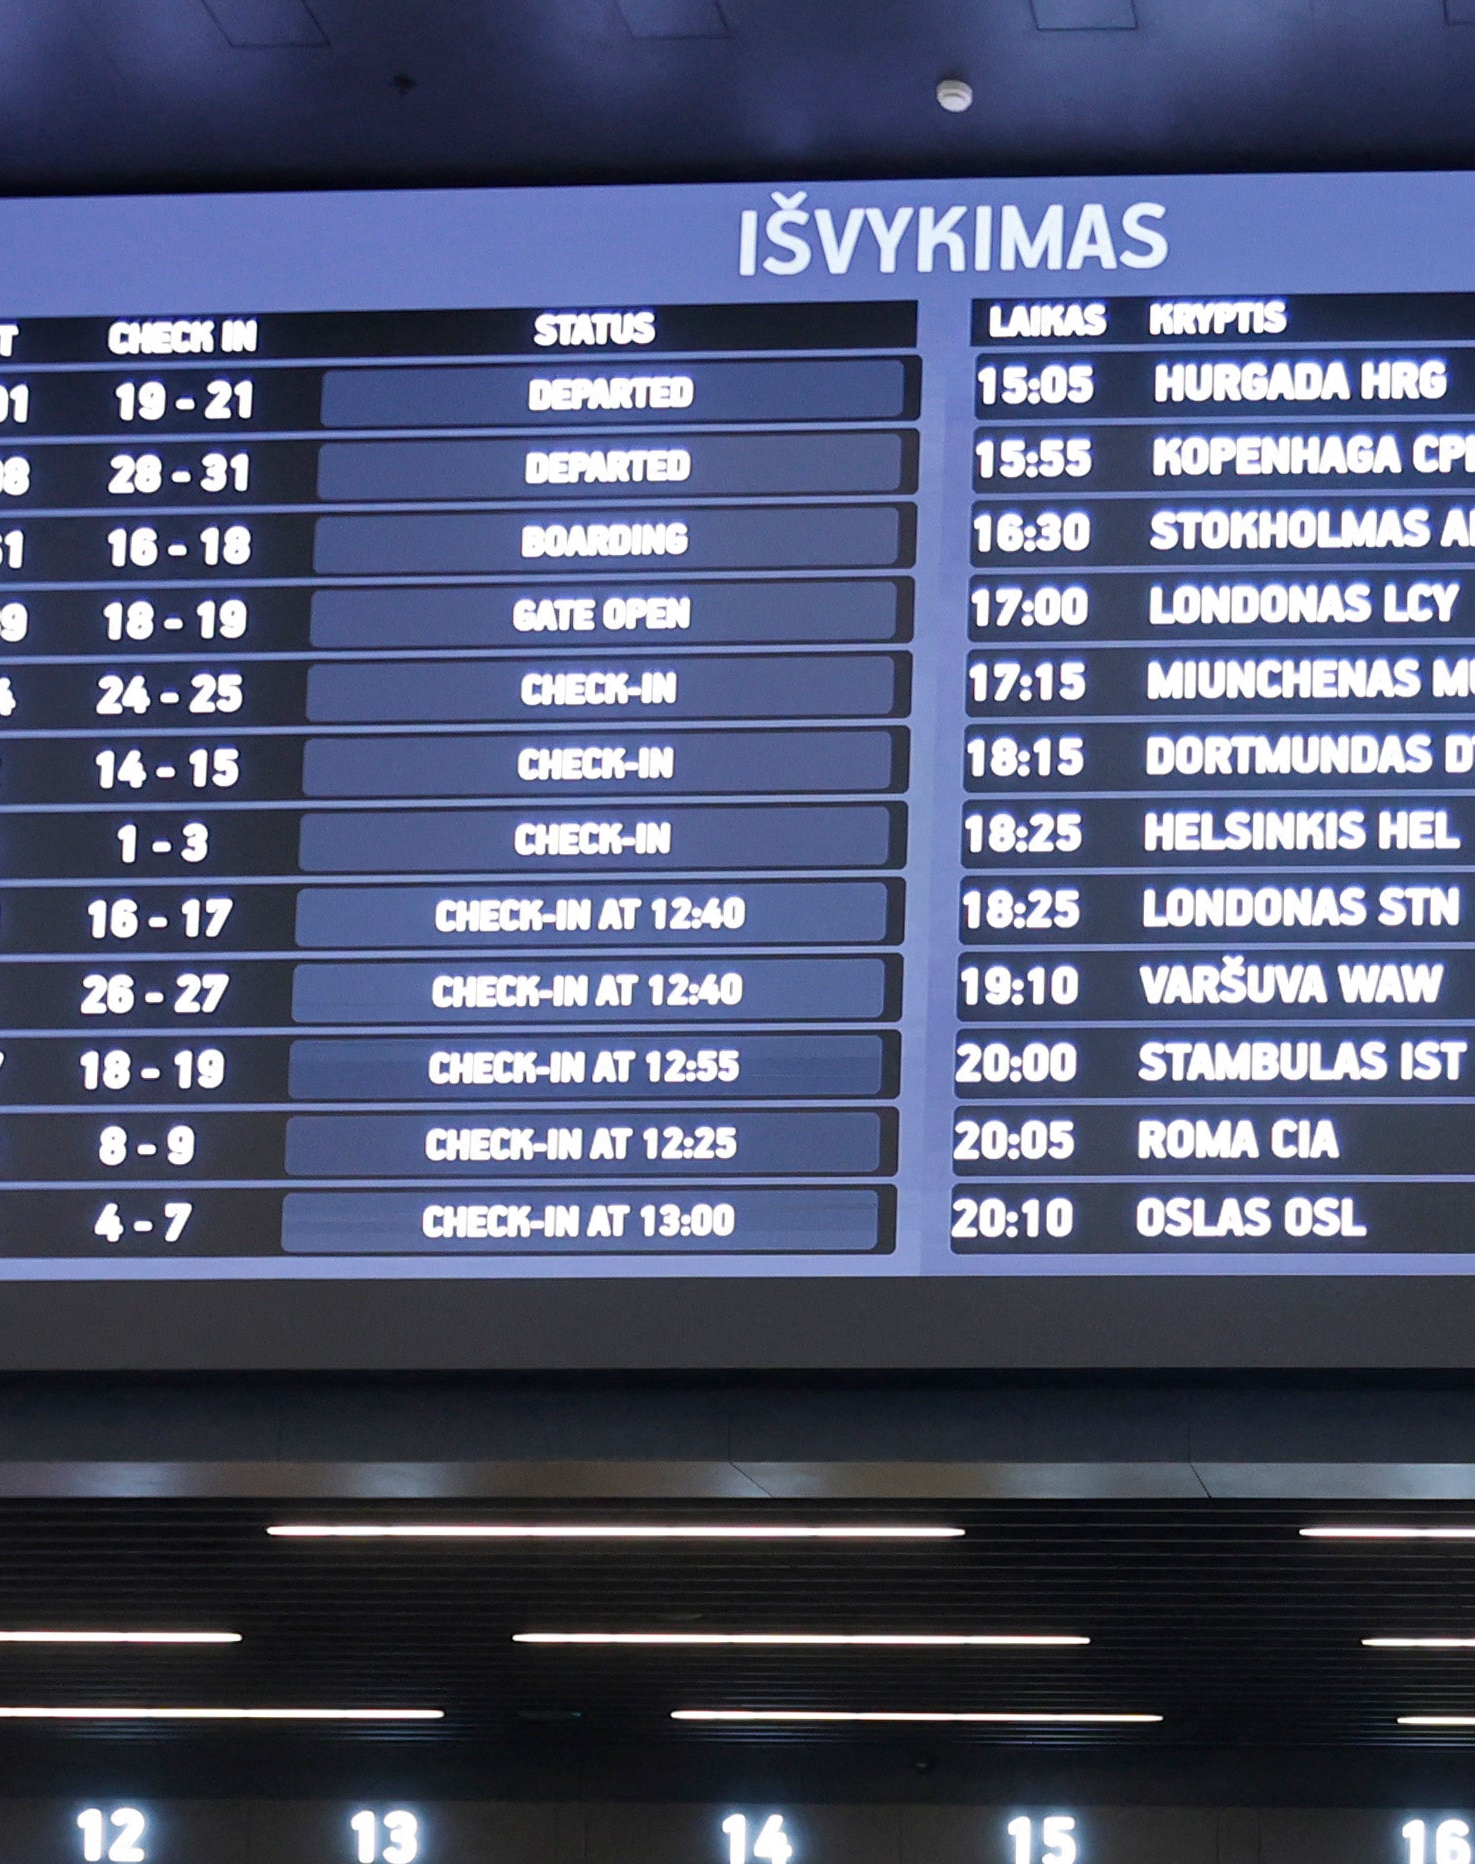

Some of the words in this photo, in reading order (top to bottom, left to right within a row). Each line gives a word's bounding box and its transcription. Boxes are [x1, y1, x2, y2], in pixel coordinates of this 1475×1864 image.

[739, 190, 1169, 276] IŠVYKIMAS
[108, 321, 214, 354] CHECK
[221, 320, 257, 352] IN
[534, 312, 656, 346] STATUS
[989, 304, 1107, 337] LAIKAS
[1149, 301, 1287, 335] KRYPTIS
[529, 376, 694, 411] DEPARTED
[978, 365, 1094, 404] 15:05
[1155, 362, 1350, 402] HURGADA
[1361, 361, 1447, 399] HRG
[525, 449, 691, 484] DEPARTED
[976, 439, 1091, 478] 15:55
[1153, 435, 1402, 476] KOPENHAGA
[513, 599, 596, 631] GATE
[603, 597, 691, 630] OPEN
[971, 587, 1088, 626] 17:00
[1150, 584, 1372, 624] LONDONAS
[1384, 583, 1460, 622] LCY
[518, 747, 674, 780] CHECK-IN
[965, 813, 1082, 853] 18:25
[1144, 811, 1366, 851] HELSINKIS
[1379, 811, 1461, 849] HEL
[435, 899, 591, 932] CHECK-IN
[598, 898, 642, 930] AT
[651, 896, 745, 930] 12:40
[961, 966, 1078, 1005] 19:10
[1139, 955, 1328, 1004] VARŠUVA
[1337, 965, 1444, 1003] WAW
[953, 1120, 1074, 1160] 20:05
[1138, 1119, 1259, 1159] ROMA
[1271, 1119, 1339, 1158] CIA
[77, 1808, 145, 1862] 12
[351, 1810, 417, 1864] 13
